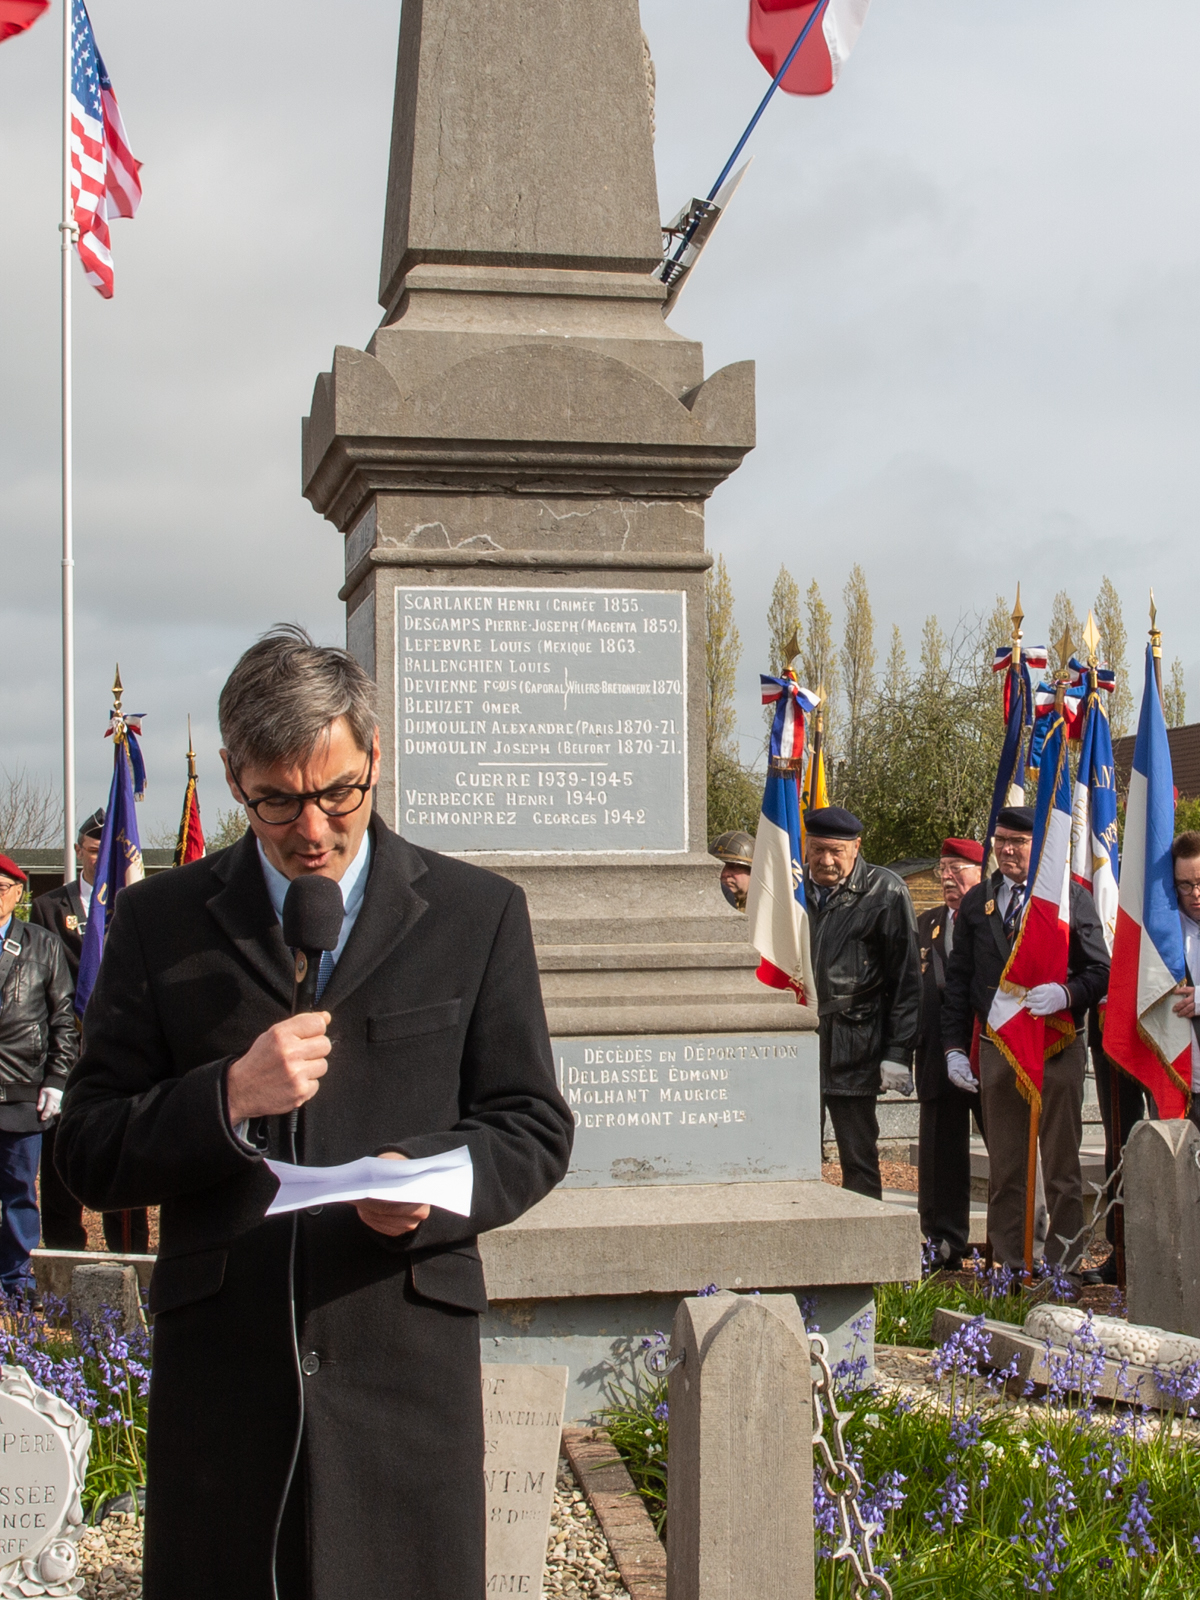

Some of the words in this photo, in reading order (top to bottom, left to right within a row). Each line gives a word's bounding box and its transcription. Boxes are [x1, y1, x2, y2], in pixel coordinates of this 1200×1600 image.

[404, 593, 493, 611] SCARLAKEN
[497, 597, 541, 612] HENRI
[404, 615, 481, 632] DESCAMPS
[404, 636, 482, 653] LEFEBVRE
[490, 638, 531, 653] LOUIS
[404, 656, 503, 673] BALLENGHIEN
[509, 659, 551, 673] LOUIS
[404, 676, 478, 694] DEVIENNE
[404, 697, 473, 714] BLEUZET
[482, 701, 522, 714] OMER
[404, 718, 487, 735] DUMOULIN
[491, 722, 573, 735] ALEXANDRE
[404, 738, 487, 755] DUMOULIN
[493, 741, 550, 755] JOSEPH
[455, 771, 531, 787] GUERRE
[538, 771, 634, 788] 1939-1945
[405, 789, 496, 806] VERBECKE
[506, 792, 554, 806] HENRI
[566, 790, 608, 806] 1940
[405, 808, 518, 825] GRIMONPREZ
[532, 811, 597, 825] GEORGES
[603, 809, 646, 825] 1942
[659, 1050, 676, 1062] EN
[568, 1087, 650, 1105] MOLHANT
[659, 1088, 728, 1103] MAURICE
